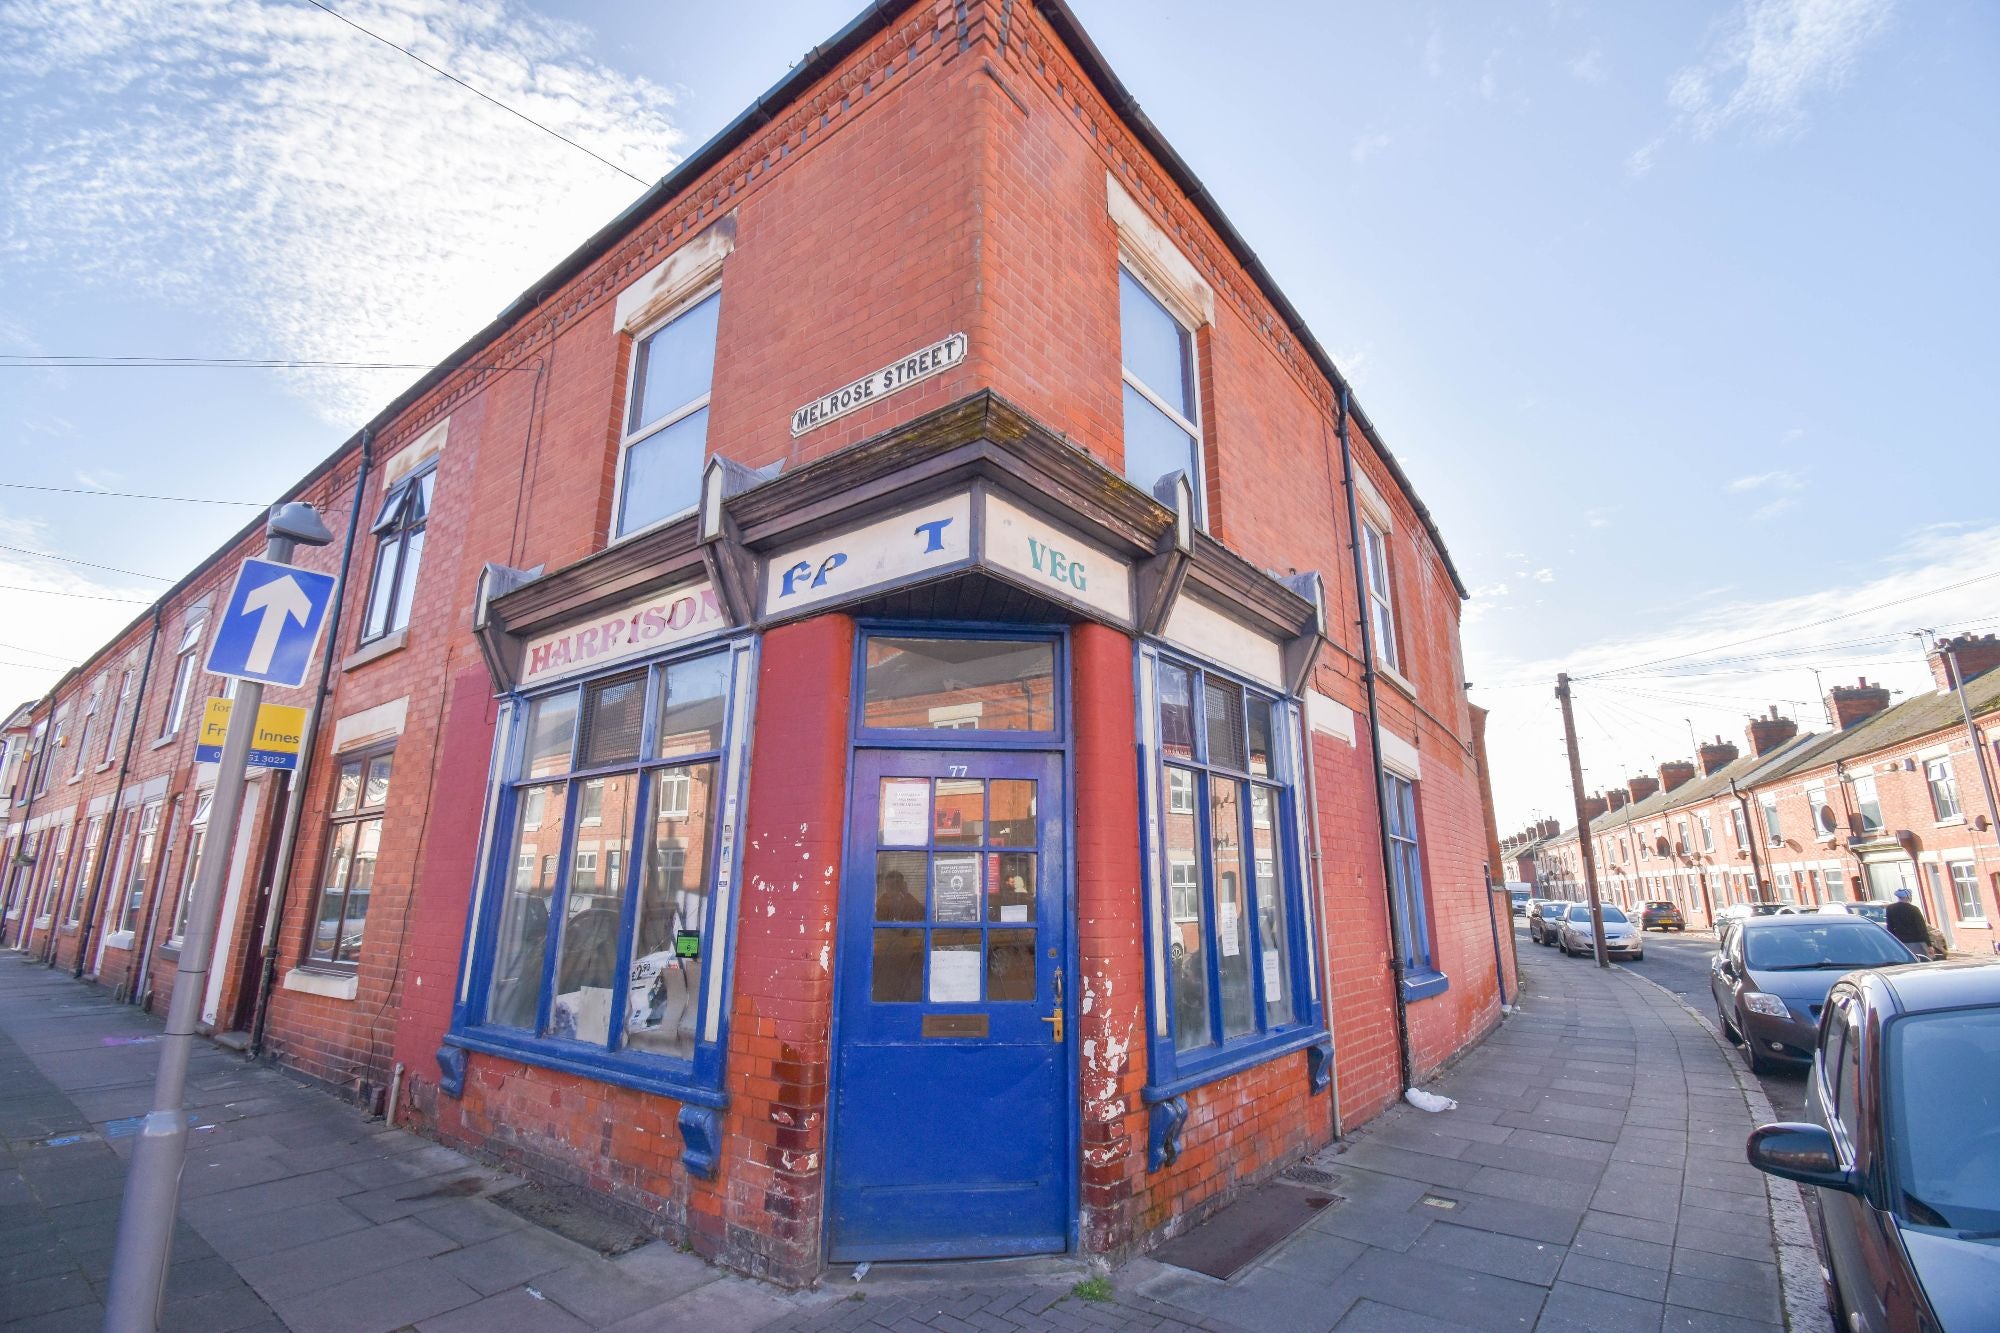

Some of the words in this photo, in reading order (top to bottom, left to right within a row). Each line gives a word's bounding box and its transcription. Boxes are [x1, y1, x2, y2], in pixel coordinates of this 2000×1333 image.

[796, 378, 874, 429] MELROSE
[883, 340, 956, 389] STREET
[1027, 535, 1087, 592] VEG
[259, 728, 300, 744] Innes
[261, 755, 286, 764] 3022
[949, 765, 968, 777] 77
